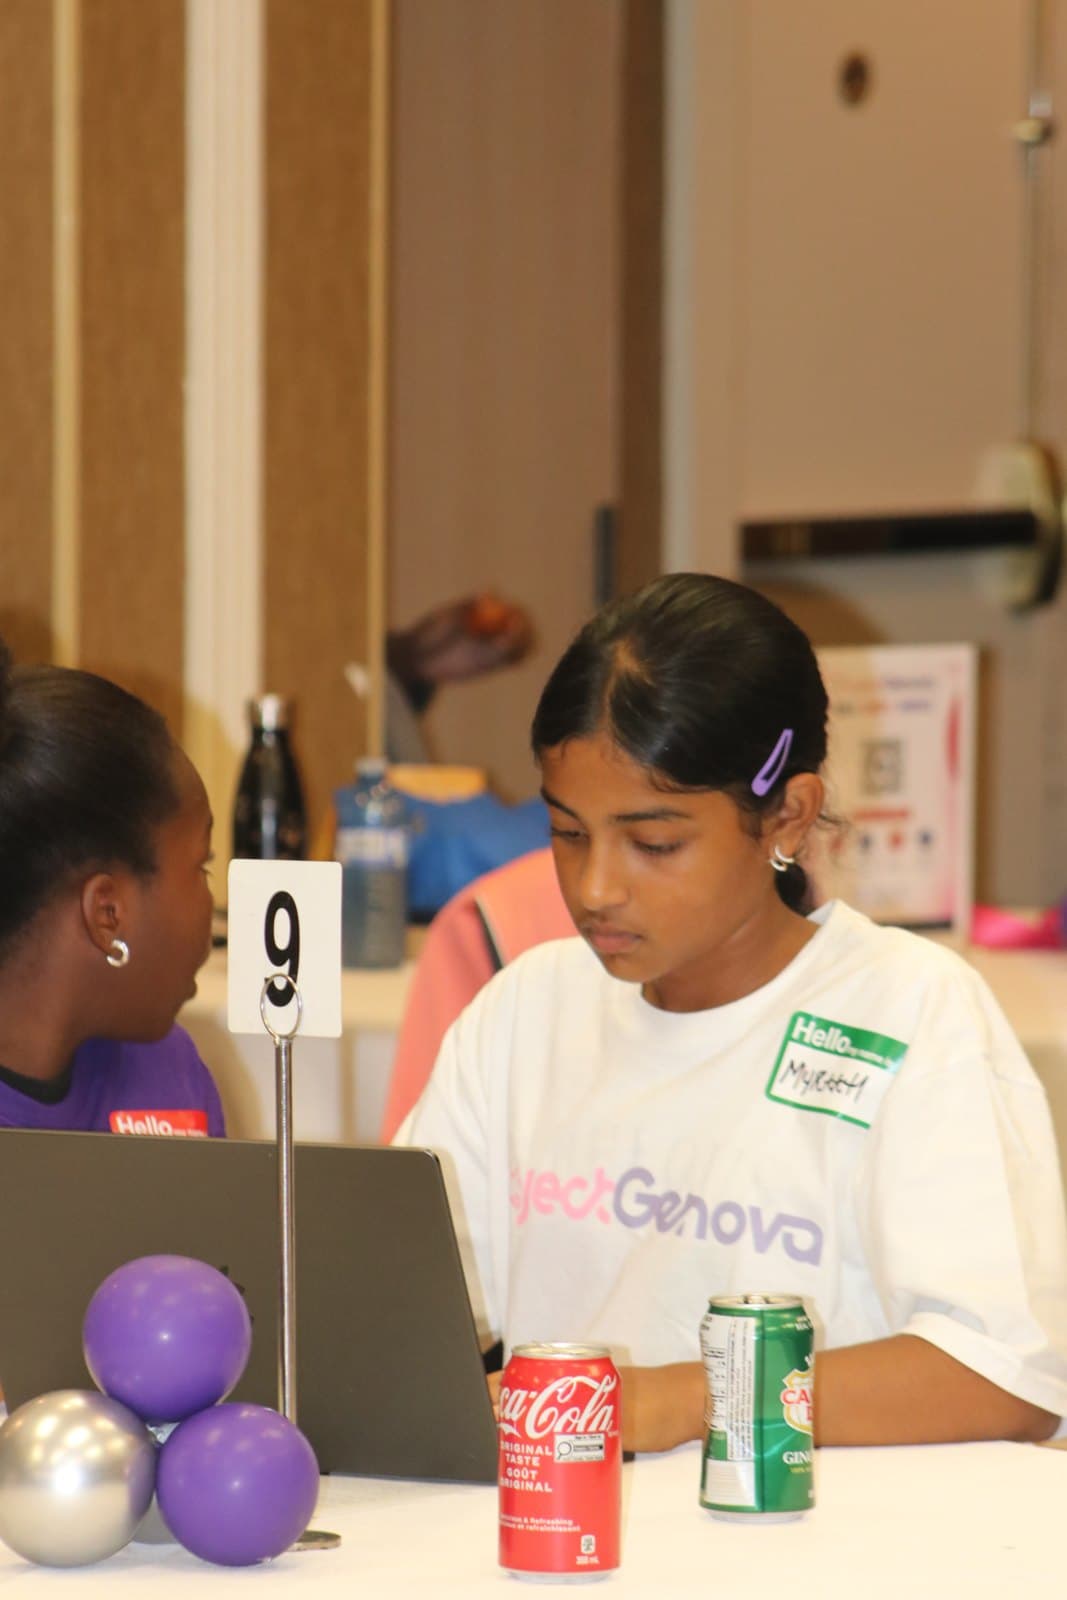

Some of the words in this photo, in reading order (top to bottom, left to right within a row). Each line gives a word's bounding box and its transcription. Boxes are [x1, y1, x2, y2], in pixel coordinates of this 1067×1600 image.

[264, 890, 300, 1007] 9
[791, 1016, 851, 1053] Hello
[116, 1114, 173, 1136] Hello
[783, 1388, 814, 1405] CA
[505, 1453, 541, 1467] TASTE
[506, 1466, 539, 1480] GOÛT
